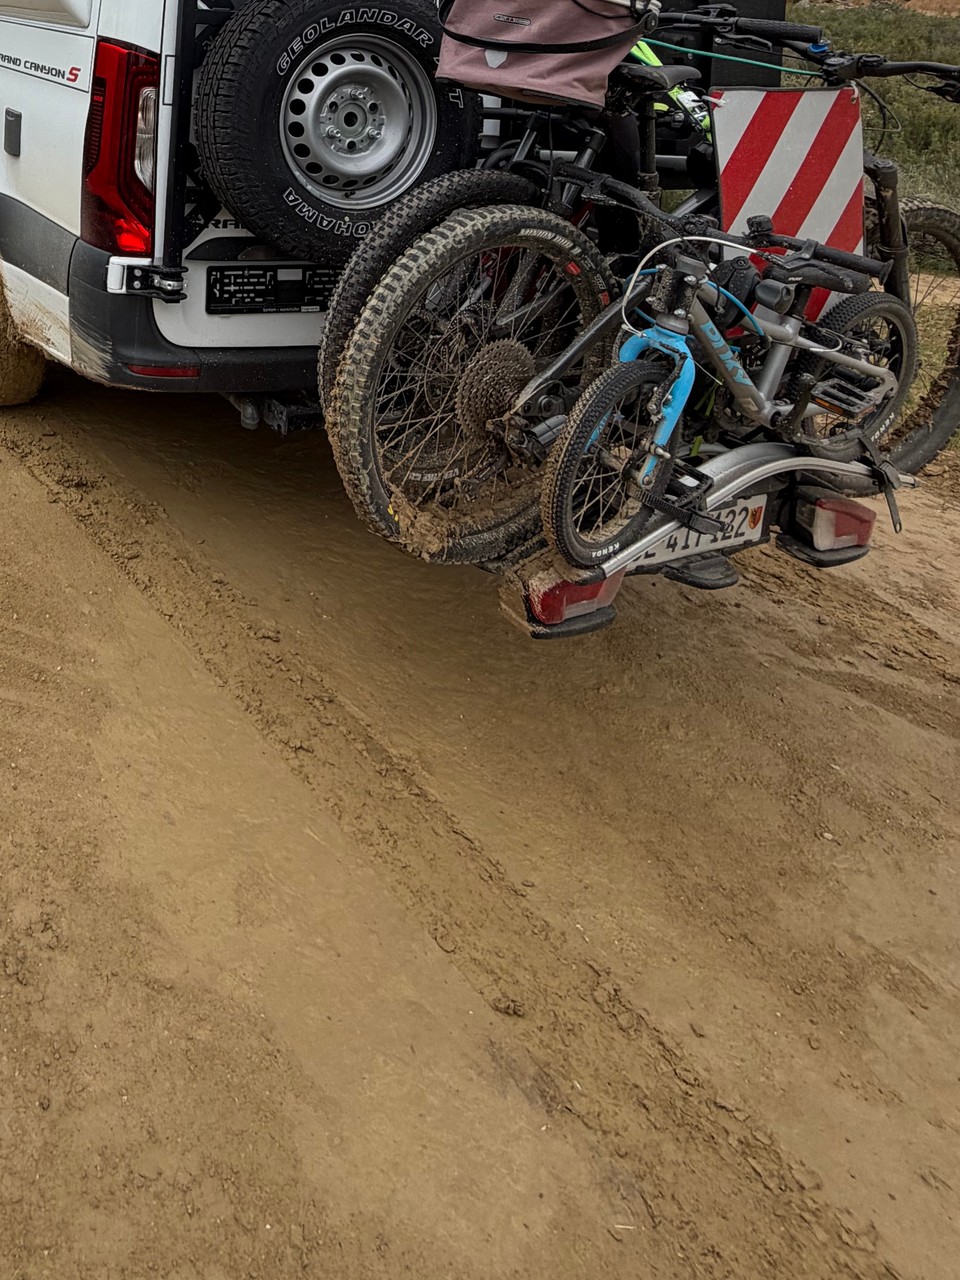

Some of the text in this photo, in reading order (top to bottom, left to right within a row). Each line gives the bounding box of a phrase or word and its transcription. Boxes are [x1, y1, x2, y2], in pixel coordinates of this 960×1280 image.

[276, 8, 435, 76] GEOLANDAR
[23, 60, 66, 80] CANYON
[66, 66, 82, 83] S
[283, 186, 372, 238] OHAMA
[870, 412, 895, 443] KENDA
[591, 542, 620, 558] KENDA
